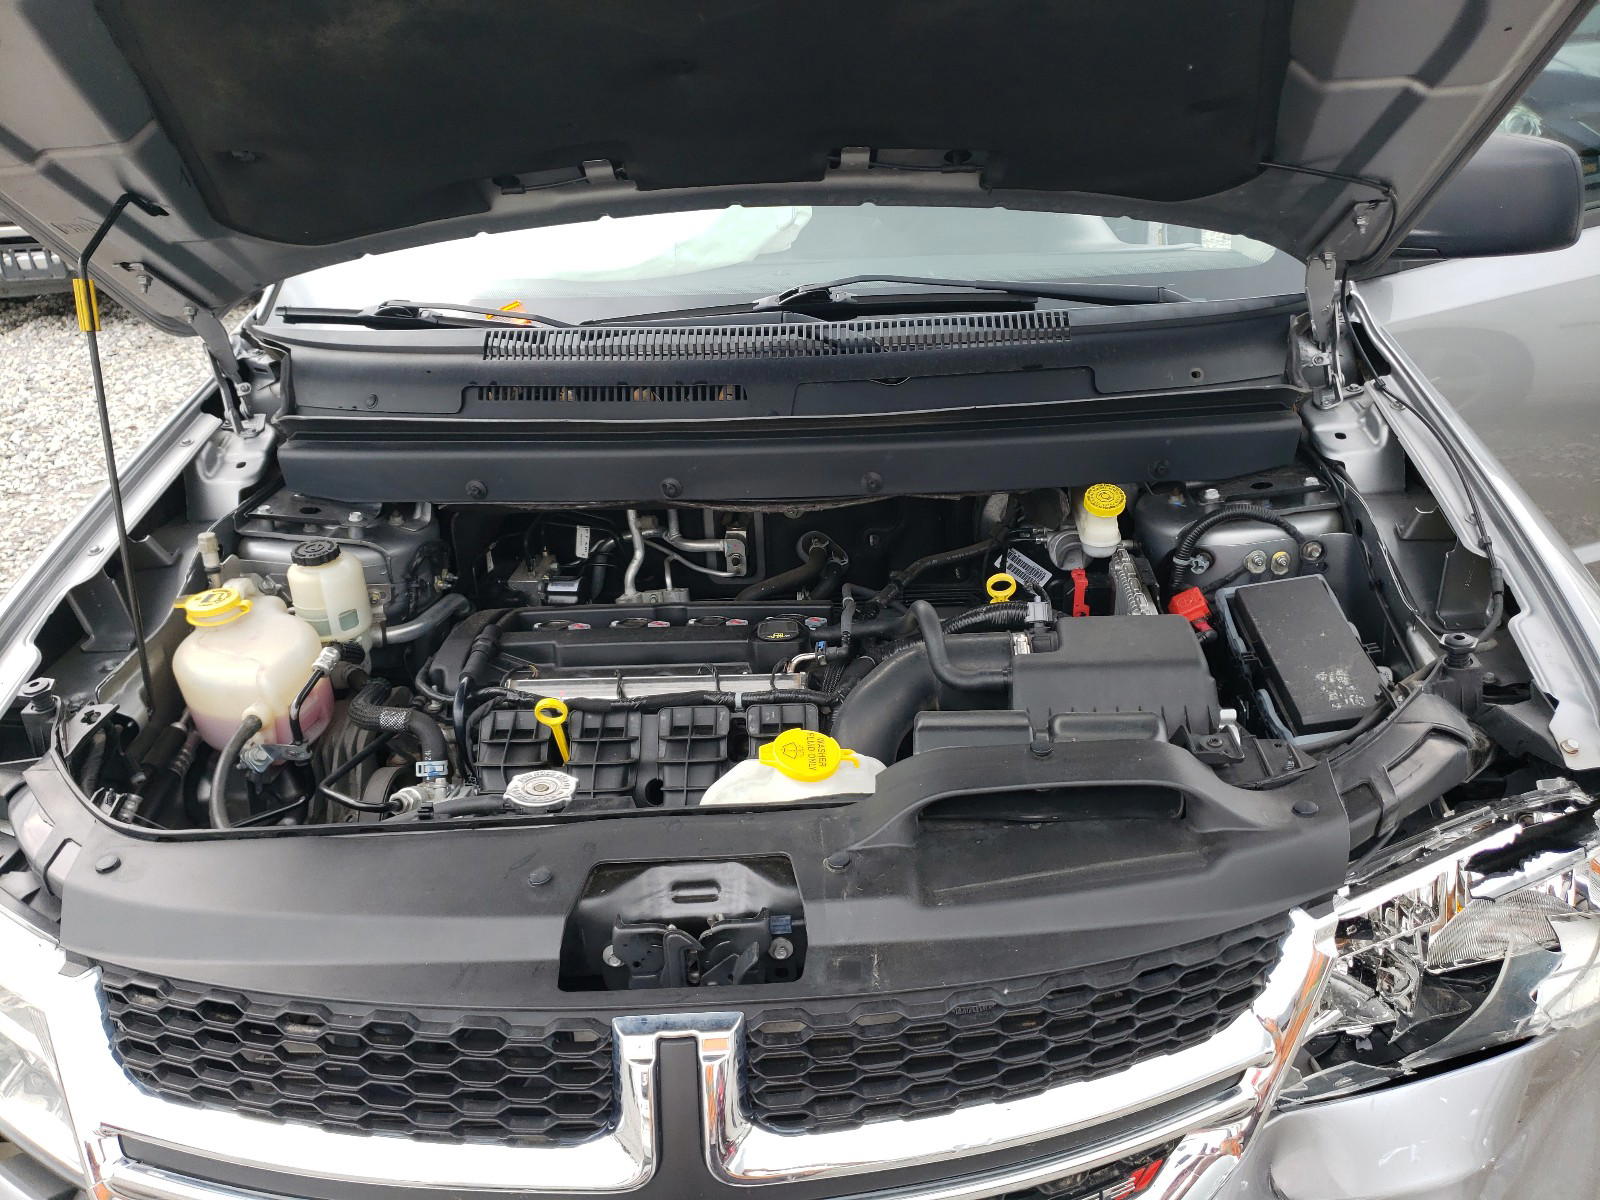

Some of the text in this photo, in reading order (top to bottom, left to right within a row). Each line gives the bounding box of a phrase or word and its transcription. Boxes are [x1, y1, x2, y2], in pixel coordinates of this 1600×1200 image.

[807, 732, 817, 771] FLUID ONLY
[817, 737, 827, 768] WASHER
